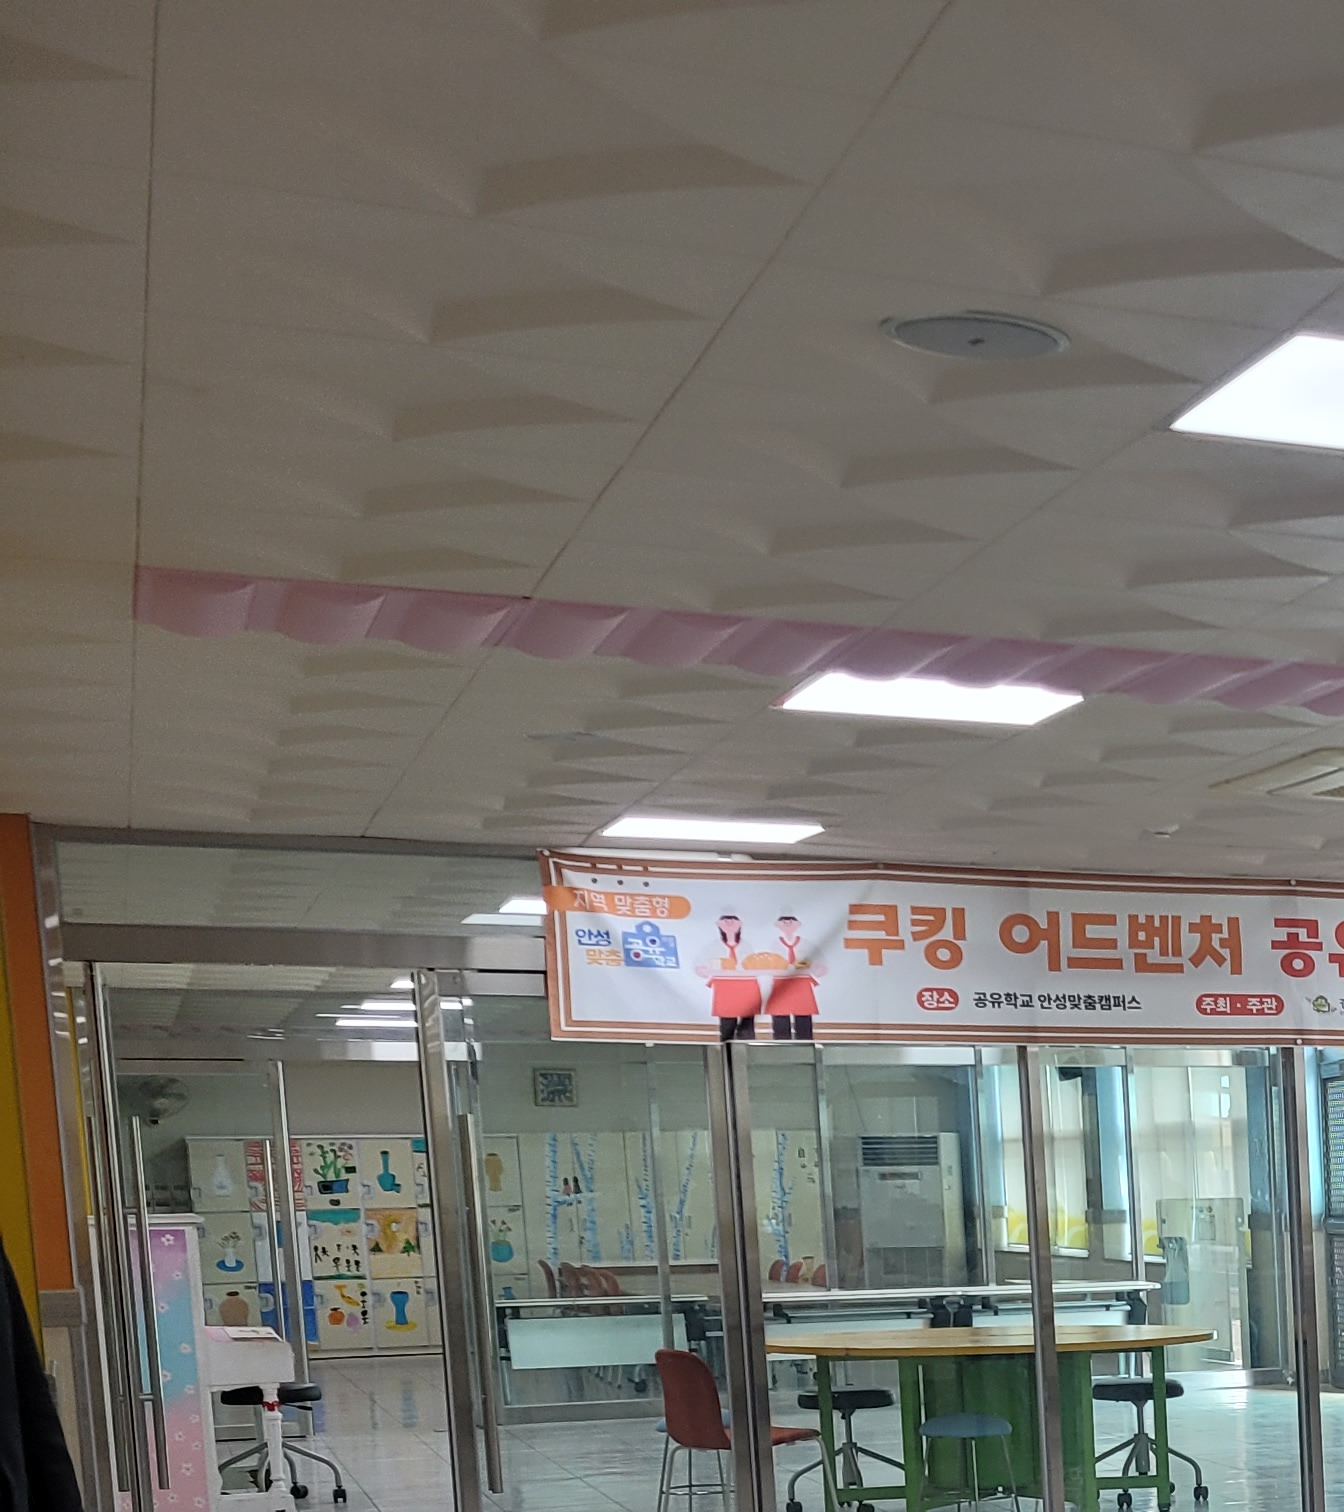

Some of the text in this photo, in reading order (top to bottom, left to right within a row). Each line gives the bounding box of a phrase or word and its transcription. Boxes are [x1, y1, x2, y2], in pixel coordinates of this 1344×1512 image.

[573, 889, 669, 918] 지역 맞춤형
[575, 928, 612, 947] 안성
[843, 903, 967, 970] 쿠킹
[999, 911, 1243, 975] 어드벤처
[585, 948, 625, 967] 맞춤
[624, 936, 667, 962] 공유
[921, 990, 956, 1009] 장소
[972, 991, 1143, 1012] 공유학교 안성맞춤캠퍼스
[1201, 997, 1278, 1014] 주최 주관
